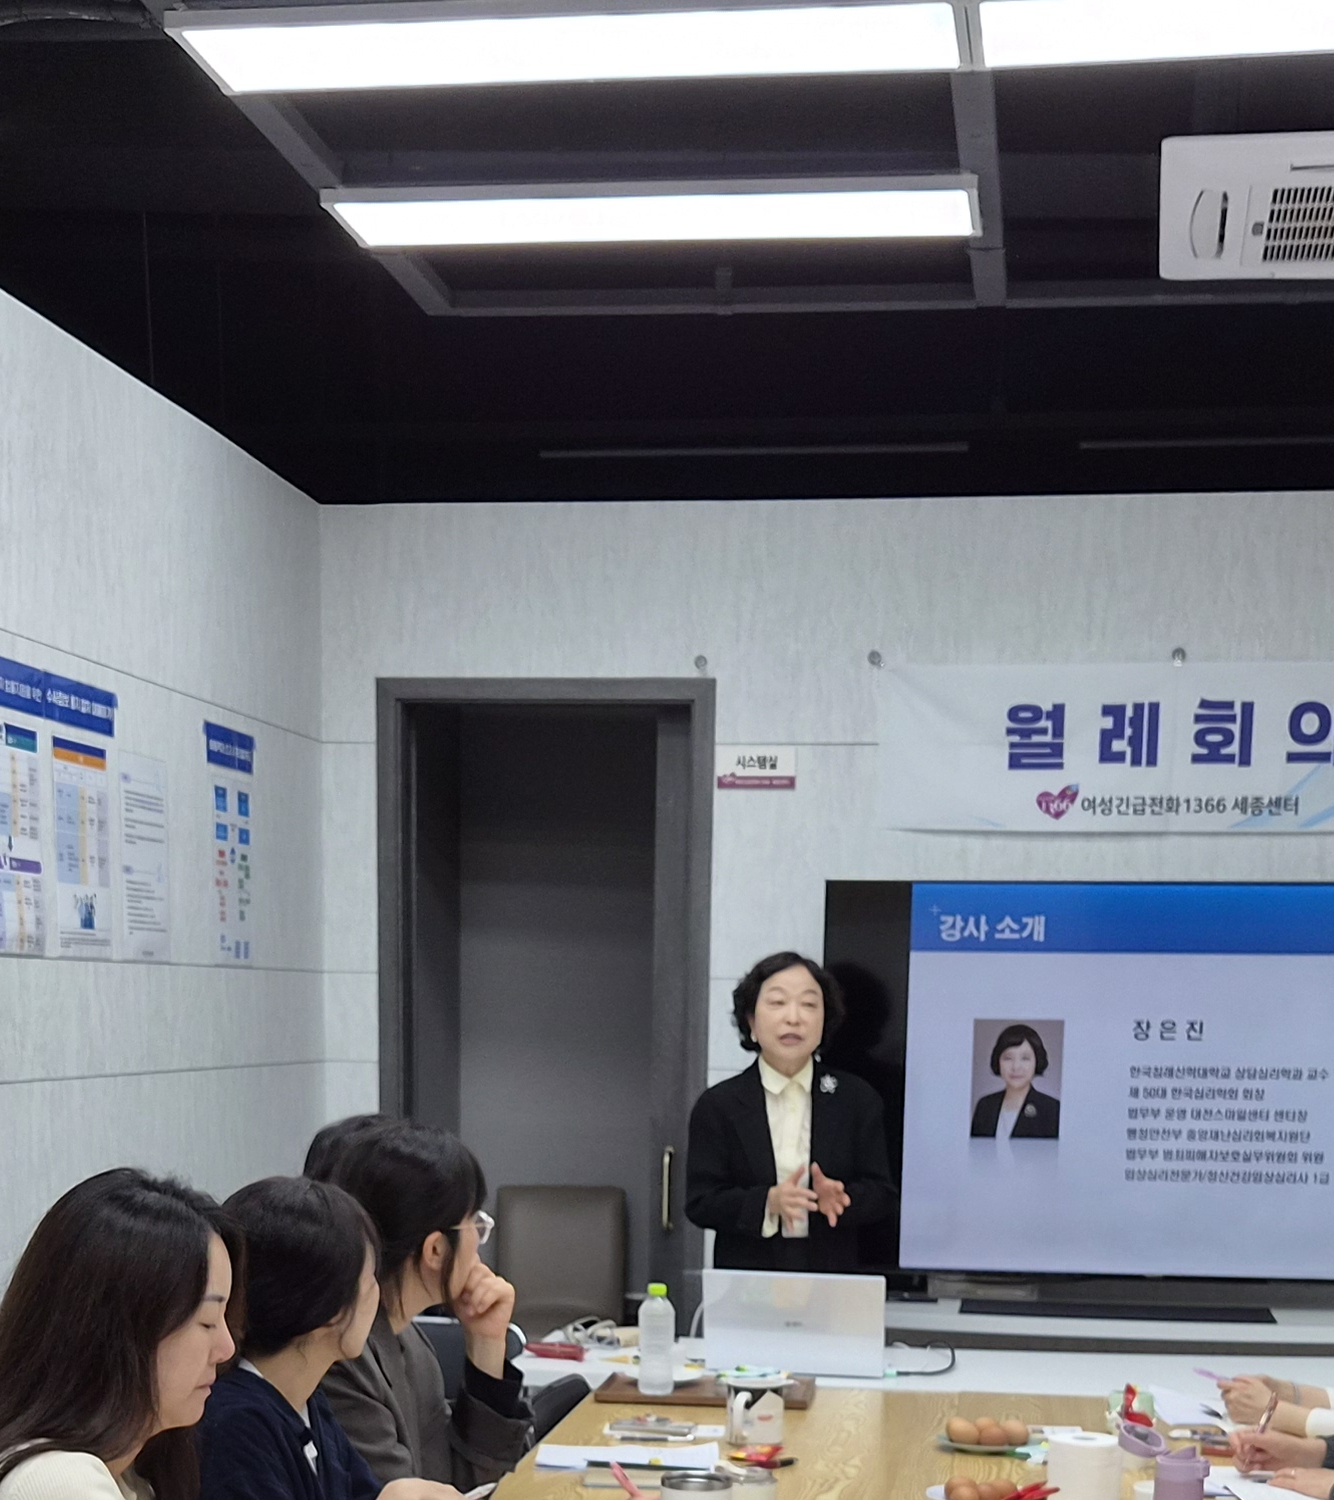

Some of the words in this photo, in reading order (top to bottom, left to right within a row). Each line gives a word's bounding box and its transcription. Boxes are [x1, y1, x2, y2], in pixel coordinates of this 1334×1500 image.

[736, 755, 778, 770] 시스템실
[1081, 796, 1227, 816] 여성긴급전화1366
[1231, 796, 1299, 816] 세종센터
[939, 914, 988, 943] 강사
[995, 914, 1046, 943] 소개
[1130, 1066, 1231, 1080] 한국침례신학대학교
[1235, 1066, 1303, 1081] 상담심리학과
[1307, 1067, 1329, 1081] 교수
[1142, 1087, 1167, 1099] 50대
[1170, 1087, 1238, 1100] 한국심리학회
[1242, 1087, 1265, 1100] 회장
[1127, 1107, 1161, 1120] 법무부
[1191, 1108, 1269, 1122] 대전스마일센터
[1273, 1108, 1308, 1123] 센터장
[1126, 1128, 1183, 1141] 행정안전부
[1186, 1128, 1310, 1143] 중앙재난심리회복지원단
[1125, 1148, 1159, 1161] 법무부
[1301, 1151, 1324, 1164] 위원
